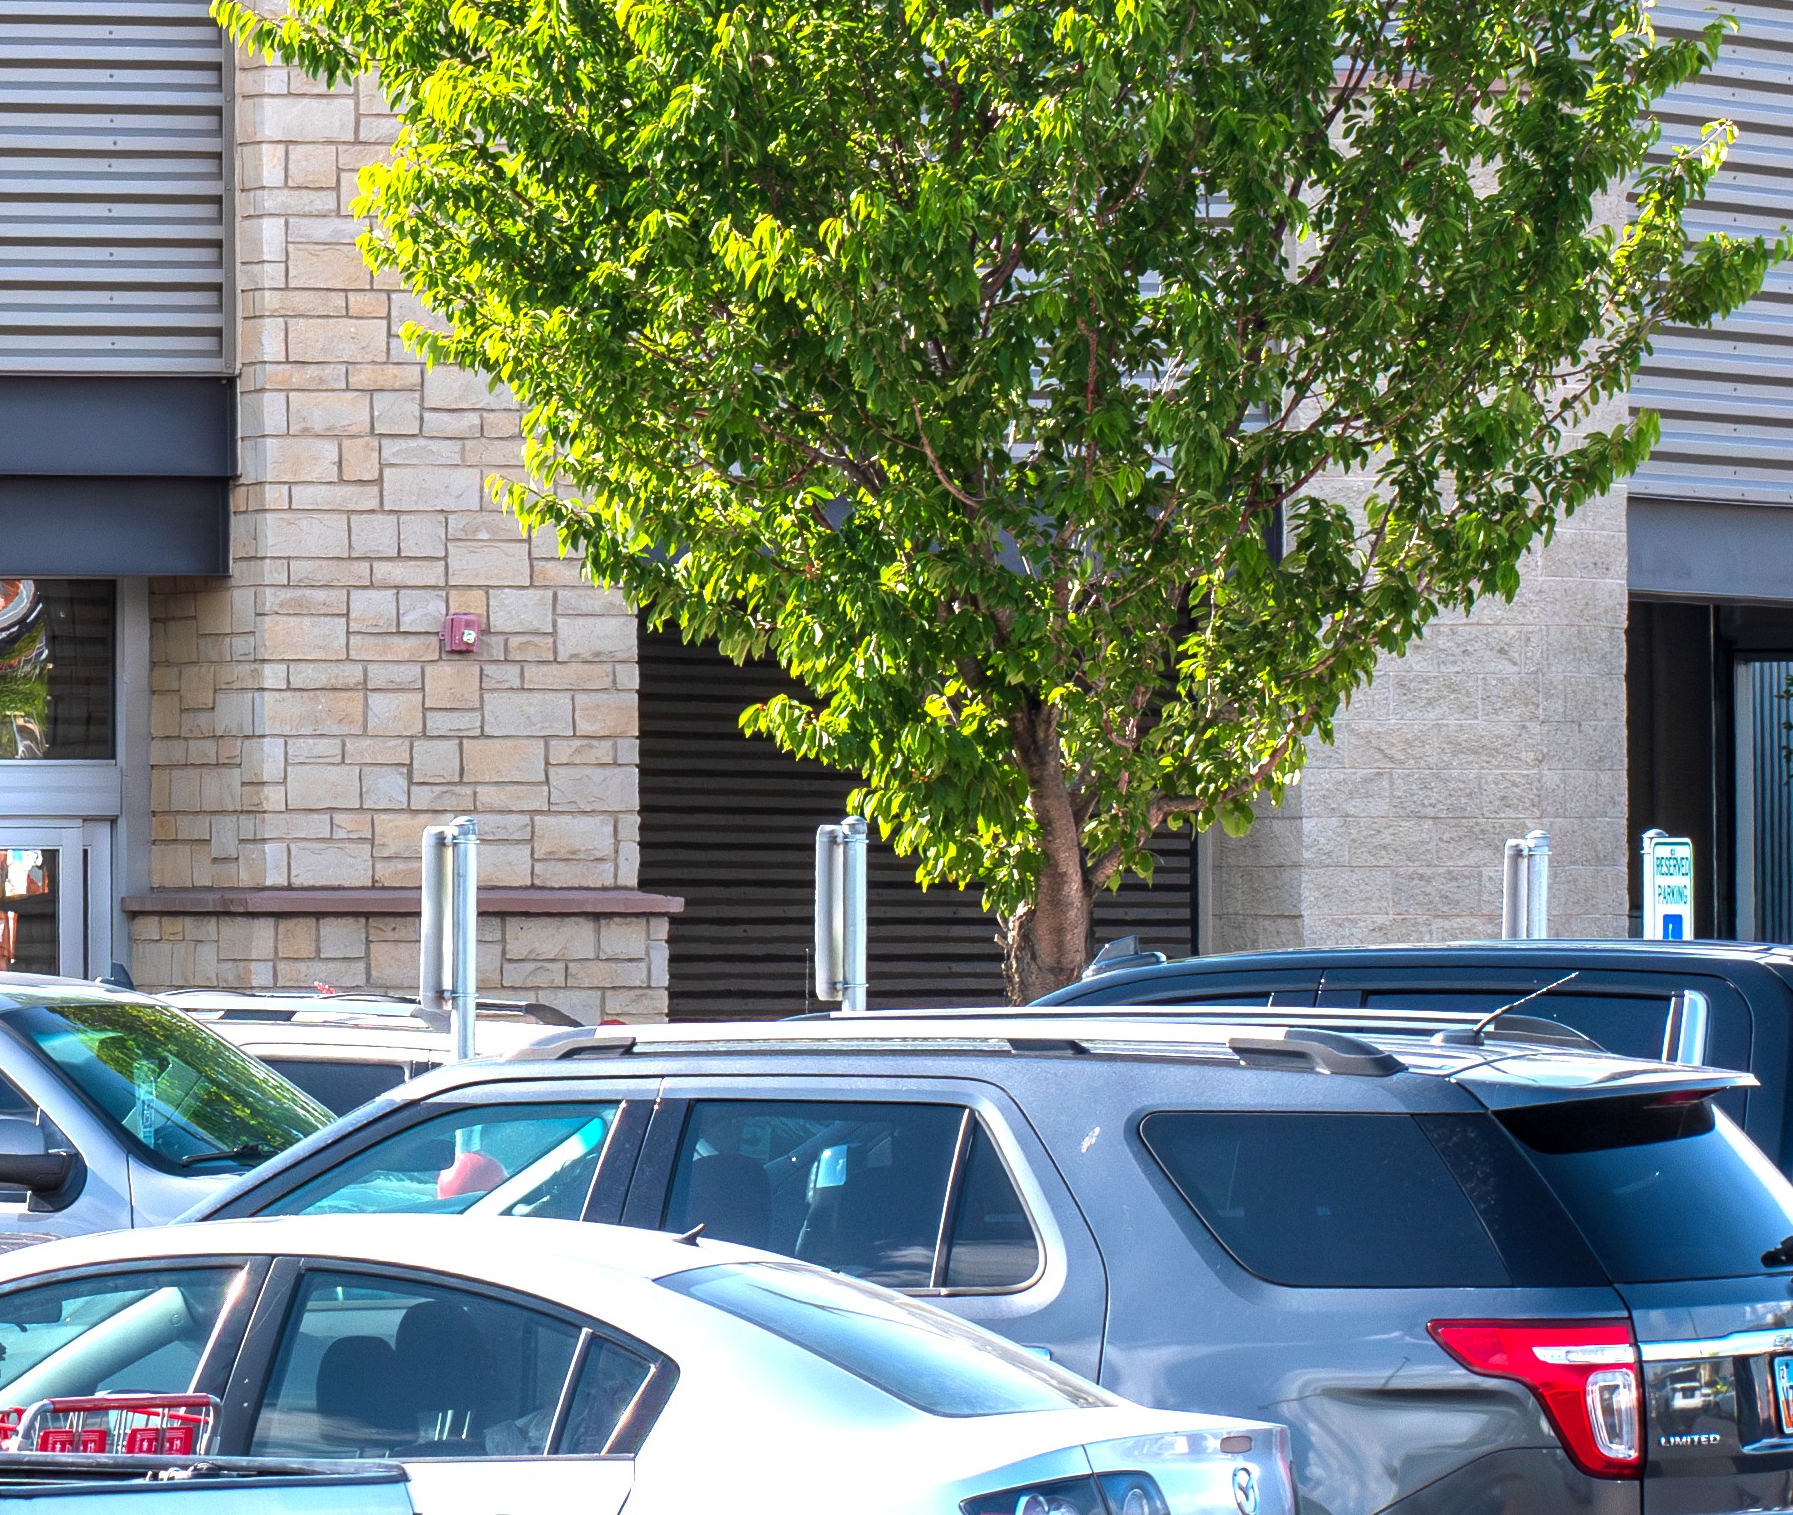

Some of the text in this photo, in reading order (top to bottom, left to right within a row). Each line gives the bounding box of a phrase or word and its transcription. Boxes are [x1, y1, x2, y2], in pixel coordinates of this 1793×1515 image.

[1656, 856, 1689, 876] RESERVED
[1657, 885, 1688, 905] PARKING
[1660, 1433, 1721, 1447] LIMITED
